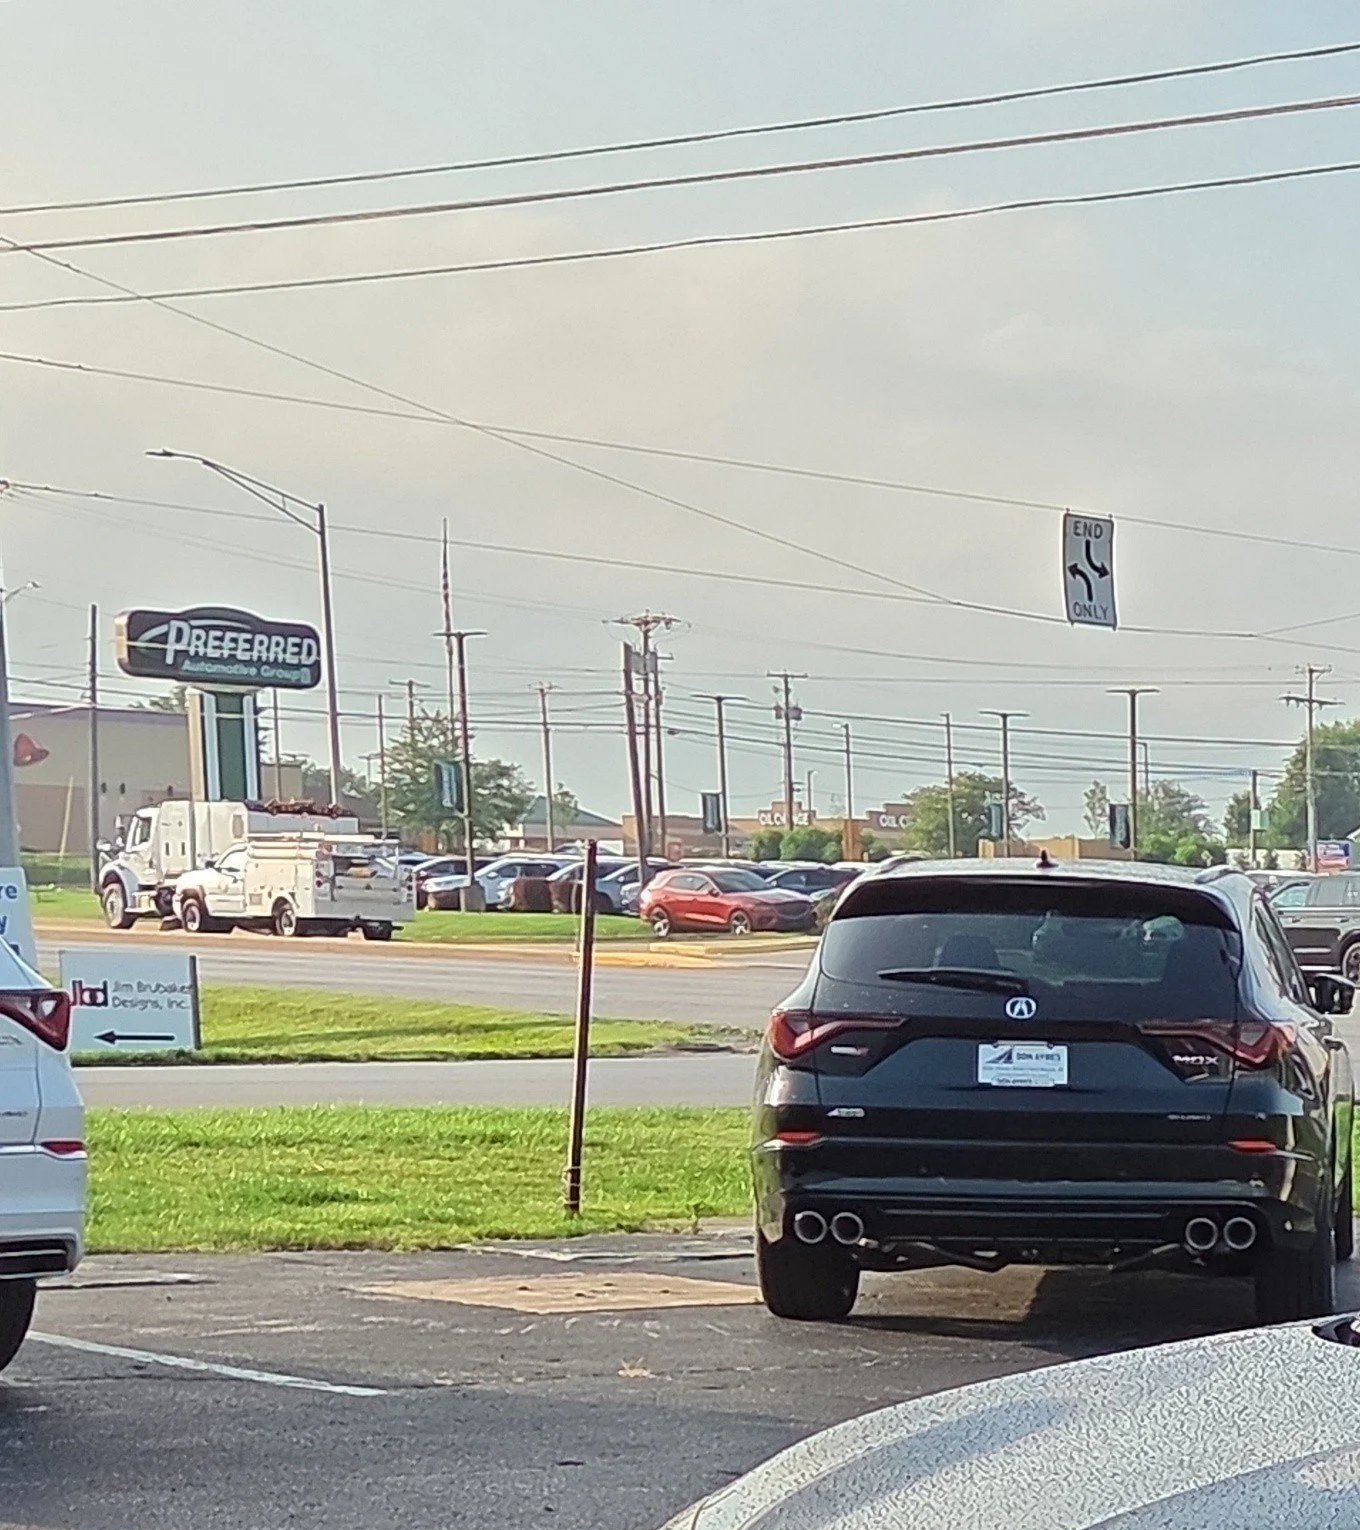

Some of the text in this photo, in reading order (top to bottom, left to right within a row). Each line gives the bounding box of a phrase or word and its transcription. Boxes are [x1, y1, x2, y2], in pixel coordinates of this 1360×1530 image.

[1073, 521, 1103, 539] END
[1073, 602, 1109, 620] ONLY
[165, 619, 318, 666] PREFERRED
[181, 659, 258, 676] Automotive
[1172, 1055, 1219, 1065] MDX
